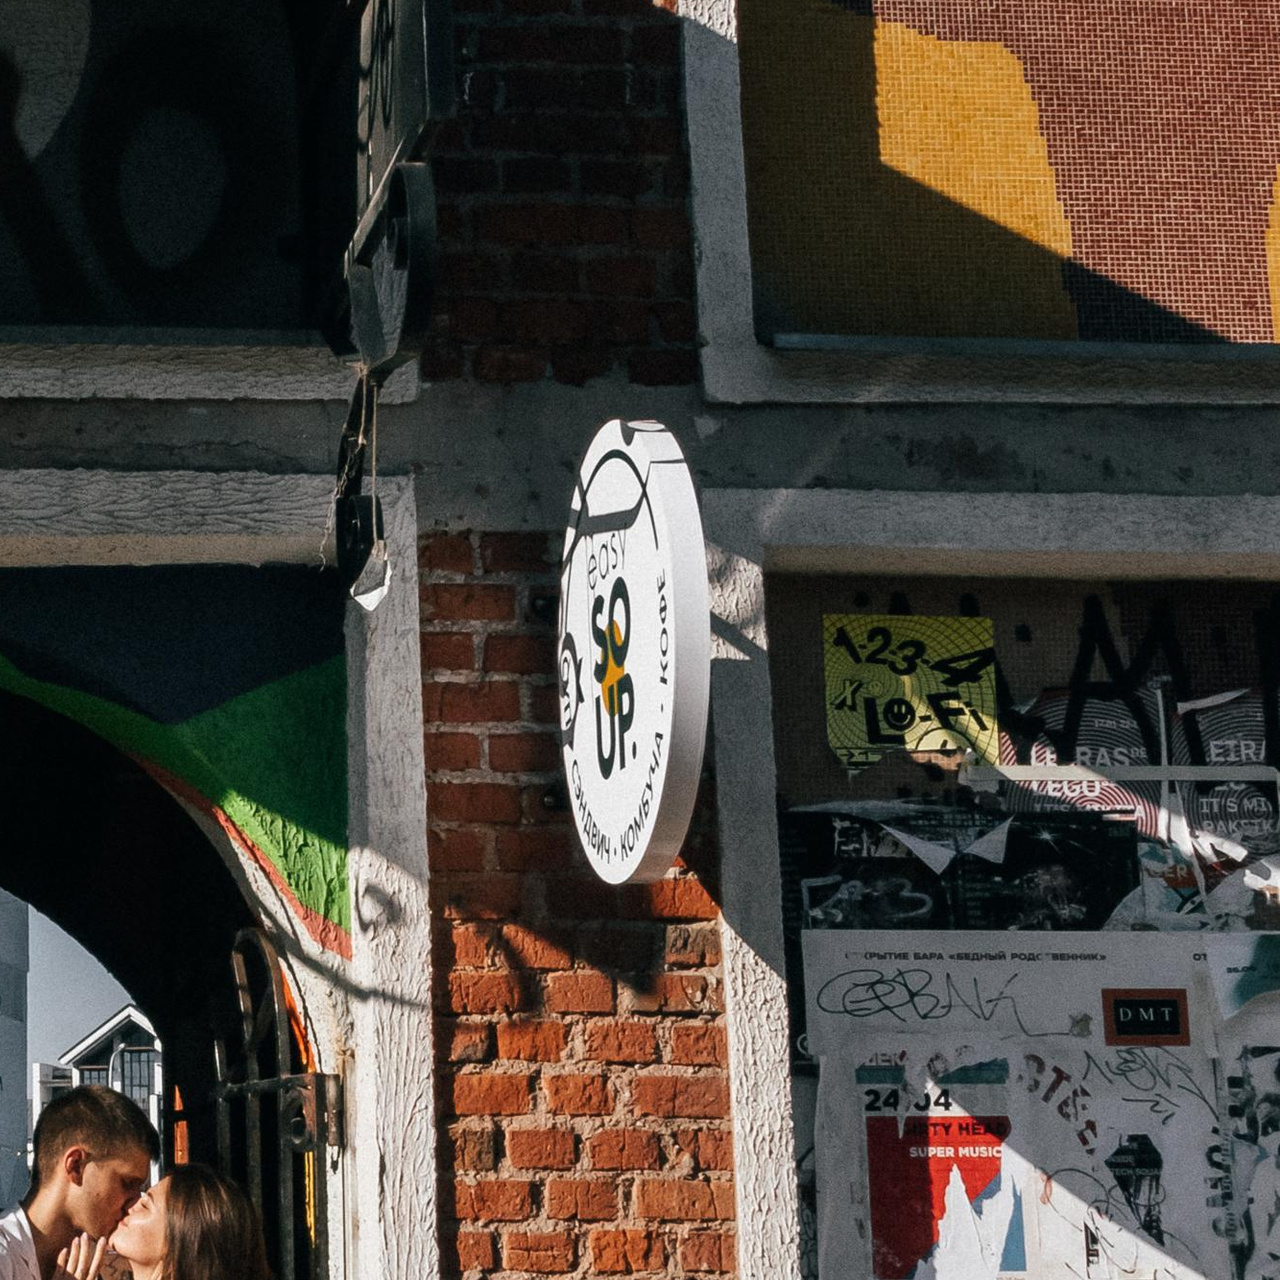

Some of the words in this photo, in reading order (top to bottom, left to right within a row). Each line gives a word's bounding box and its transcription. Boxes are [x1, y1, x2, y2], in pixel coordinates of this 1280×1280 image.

[570, 759, 611, 865] СЭНДВИЧ
[620, 730, 664, 863] КОМБУЧА
[1118, 1007, 1174, 1022] DMT
[909, 1146, 955, 1158] SUPER
[958, 1146, 1002, 1158] MUSIC
